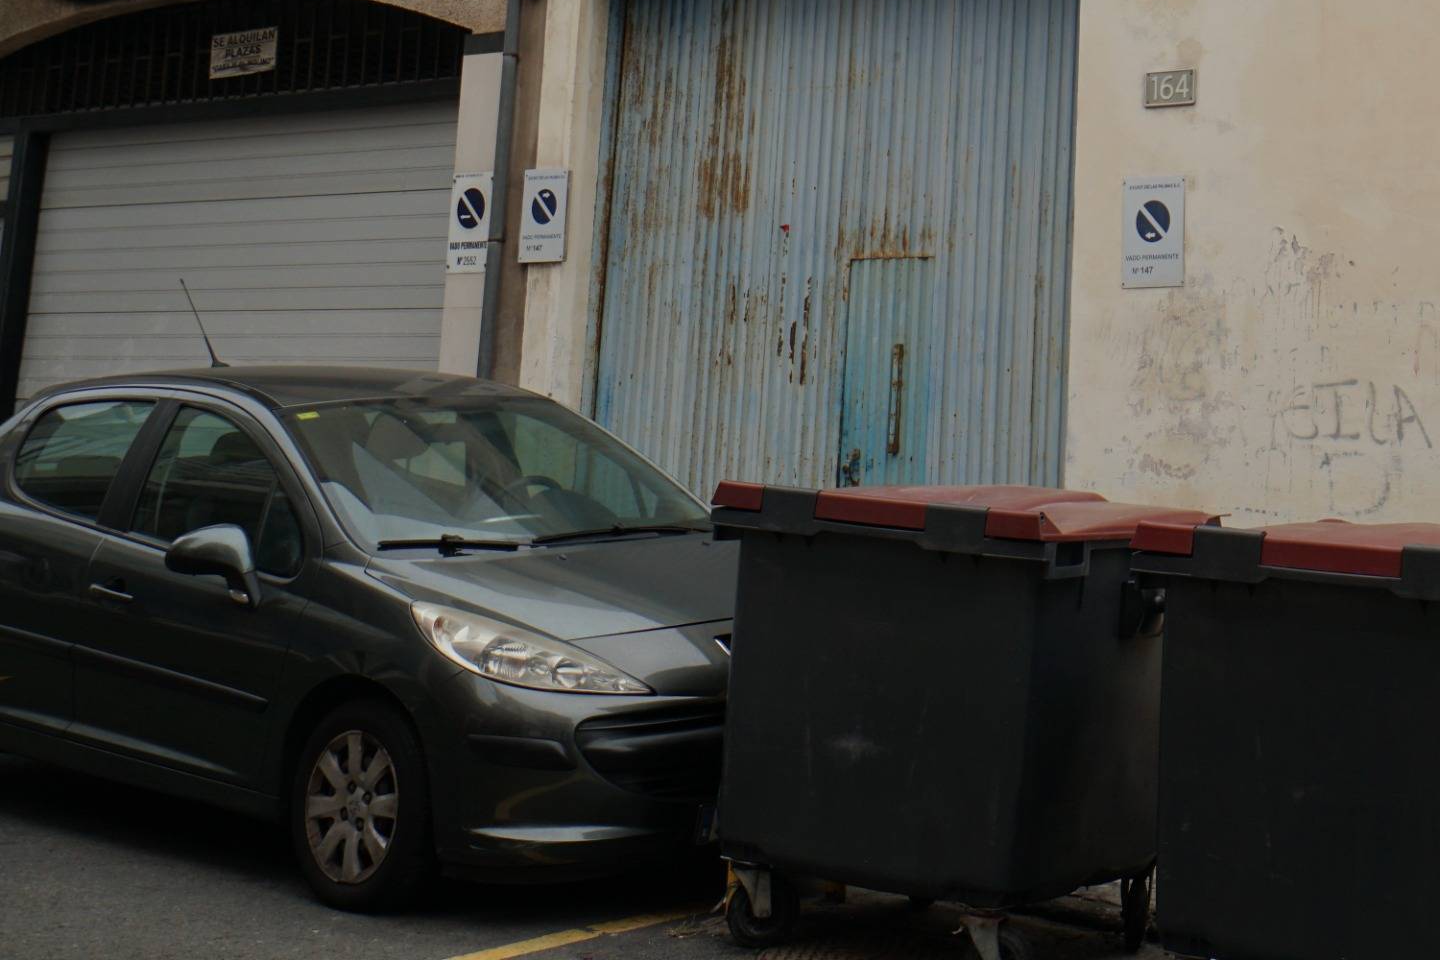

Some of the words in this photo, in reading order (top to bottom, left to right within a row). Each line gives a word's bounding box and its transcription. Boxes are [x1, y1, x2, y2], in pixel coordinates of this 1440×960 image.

[227, 29, 275, 45] ALQUILAN
[224, 45, 261, 58] PLAZAS
[1151, 73, 1189, 100] 164
[461, 241, 487, 250] PERMANENTE
[1140, 266, 1153, 274] 147
